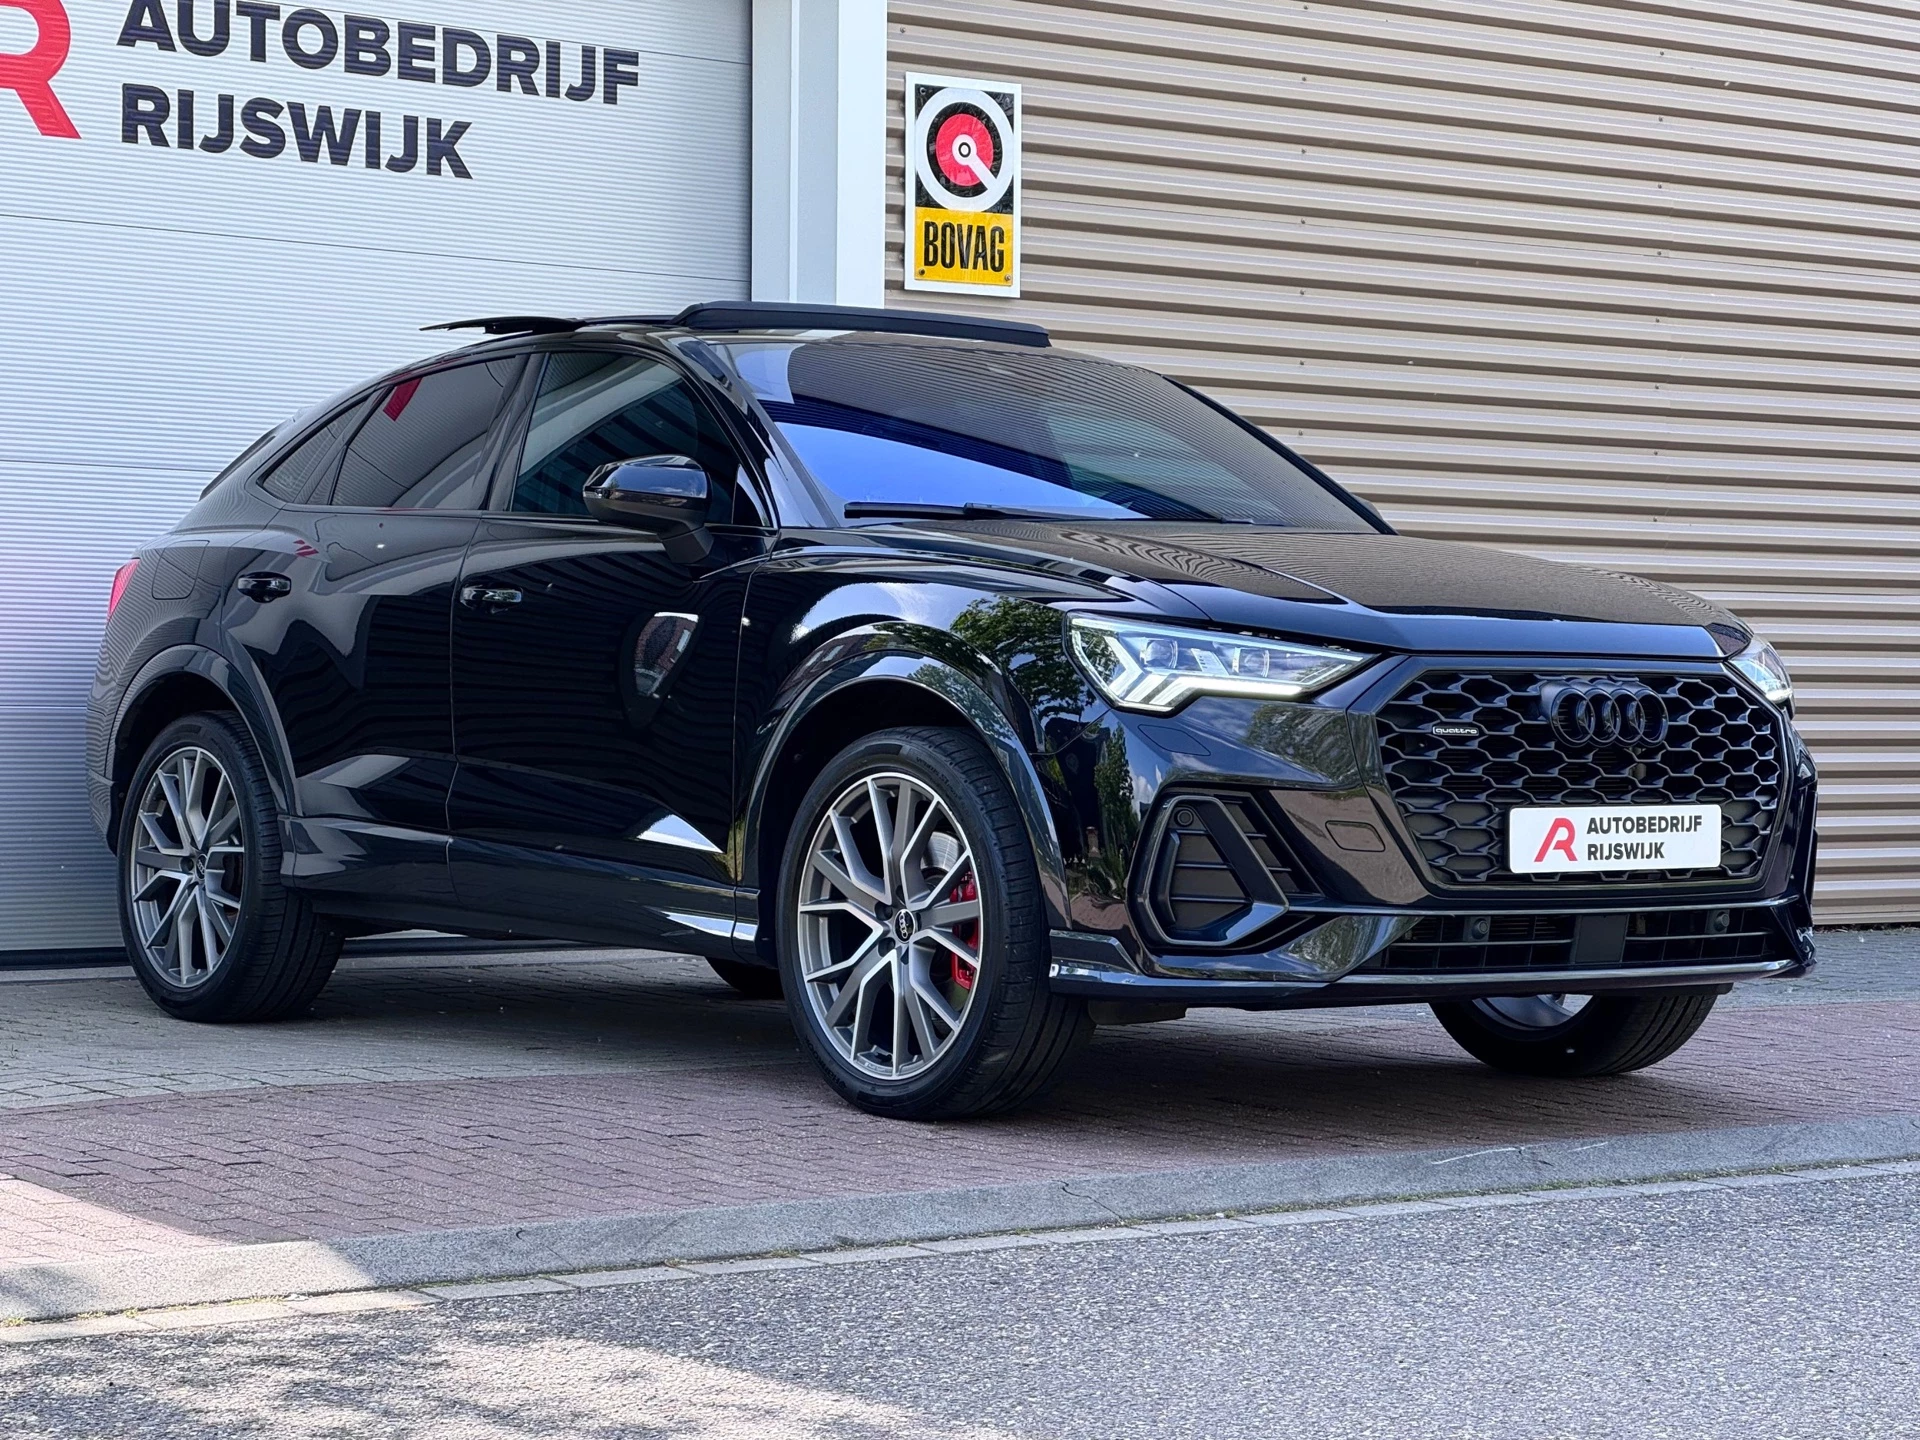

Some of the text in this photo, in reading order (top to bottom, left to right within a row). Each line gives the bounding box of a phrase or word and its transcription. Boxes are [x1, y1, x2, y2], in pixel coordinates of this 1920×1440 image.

[116, 0, 640, 105] AUTOBEDRIJF
[121, 82, 473, 180] RIJSWIJK
[923, 220, 1005, 272] BOVAG
[1435, 727, 1478, 735] quattro
[1586, 815, 1702, 835] AUTOBEDRIJF
[1587, 842, 1665, 861] RIJSWIJK
